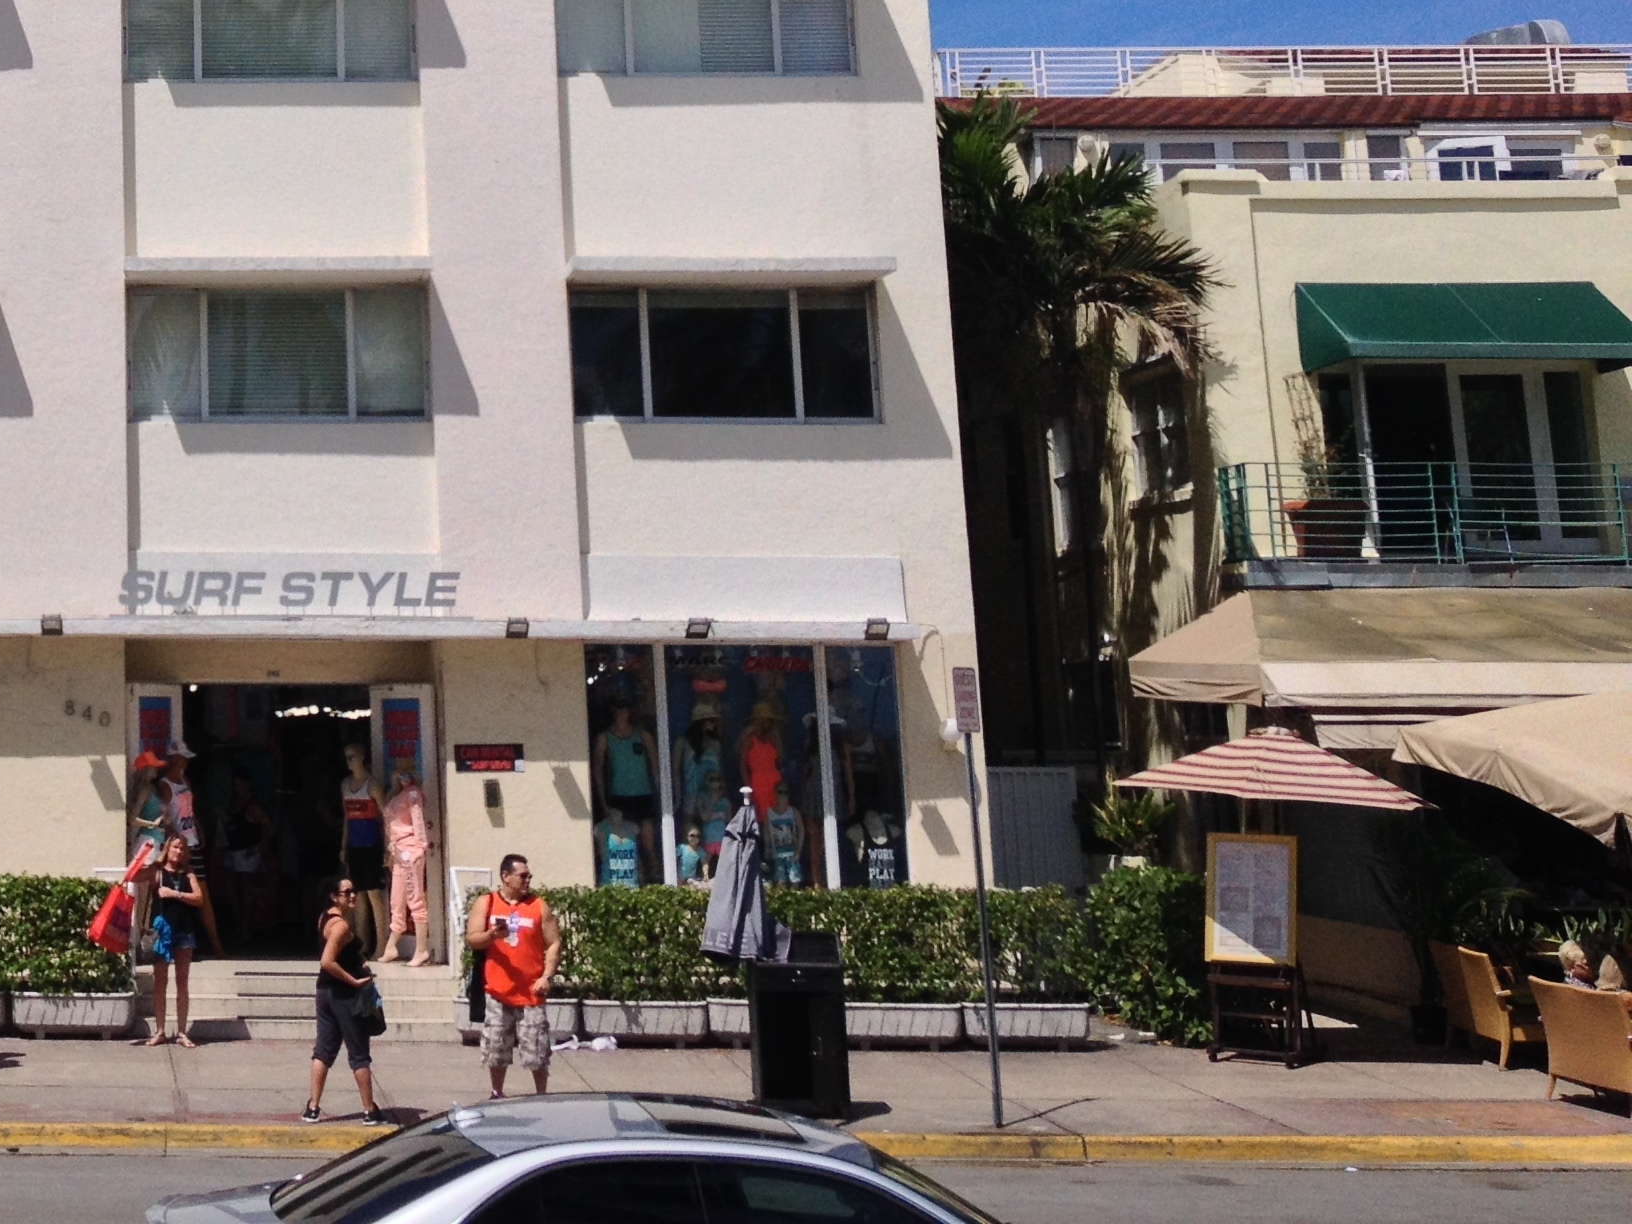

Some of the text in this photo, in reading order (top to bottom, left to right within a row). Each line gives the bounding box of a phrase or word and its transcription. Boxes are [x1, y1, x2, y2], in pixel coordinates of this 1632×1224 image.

[119, 570, 461, 608] SURF STYLE
[64, 699, 111, 727] 840
[868, 848, 894, 860] WORK
[868, 867, 895, 880] PLAY
